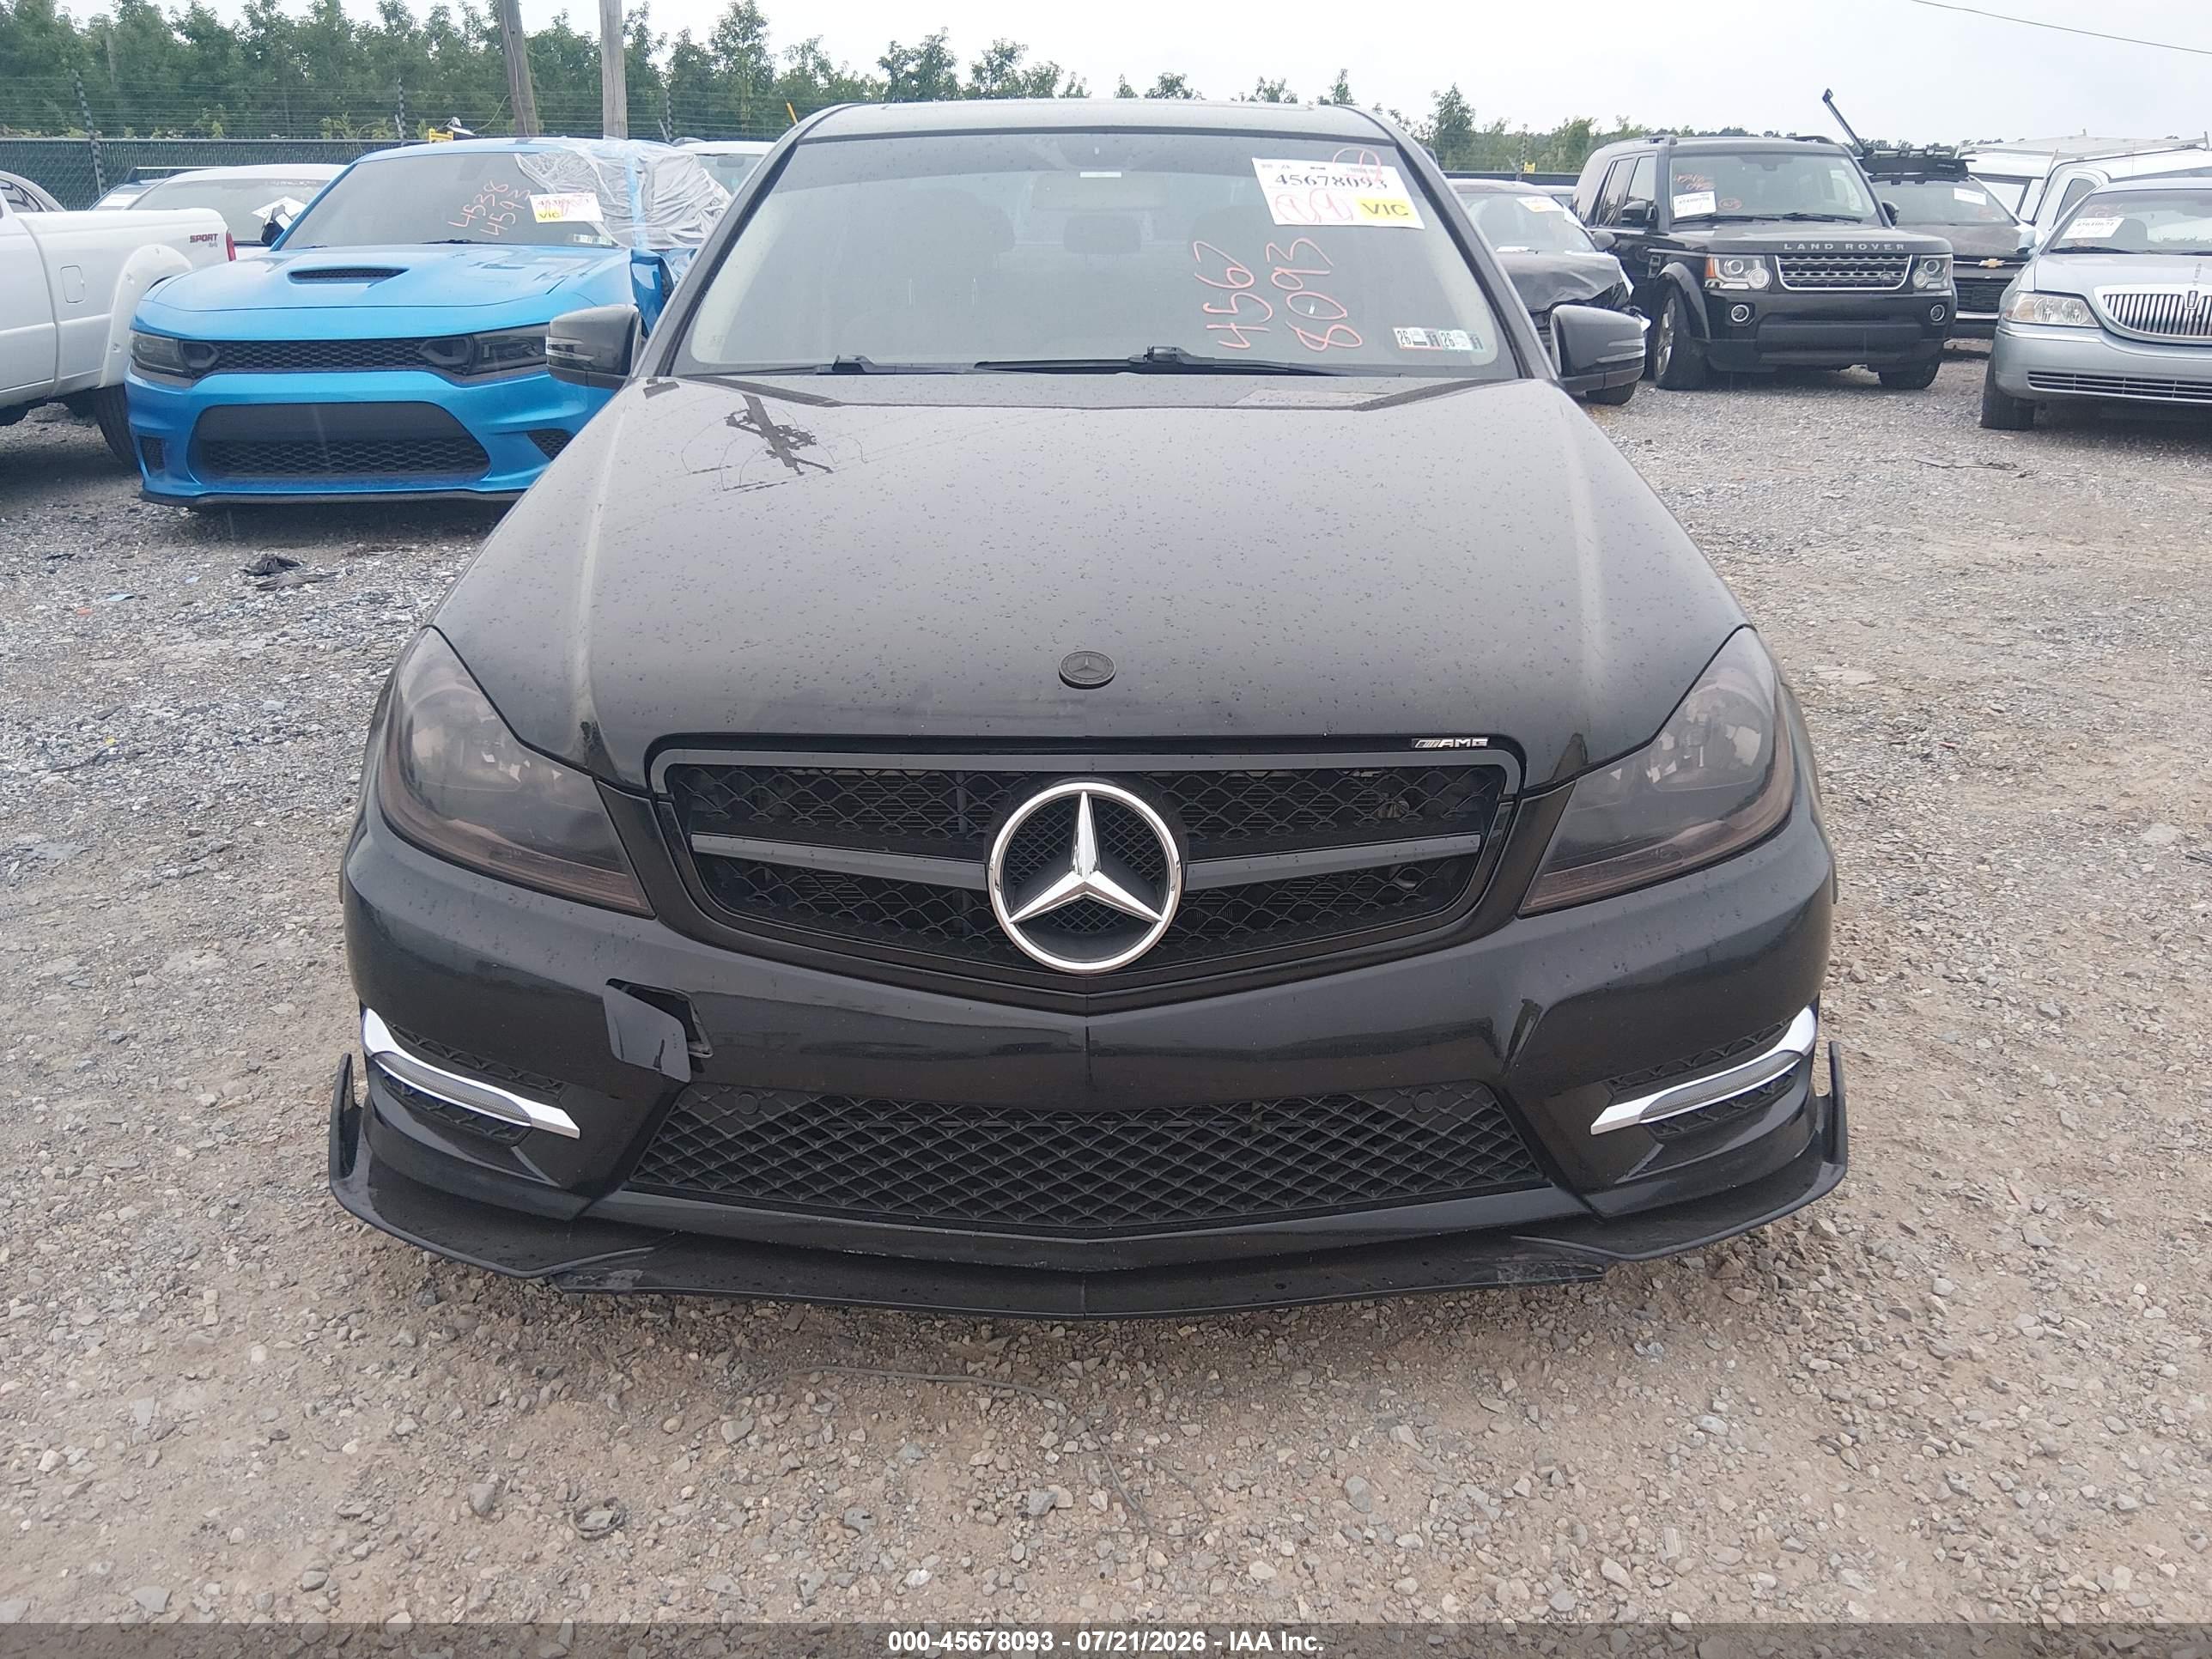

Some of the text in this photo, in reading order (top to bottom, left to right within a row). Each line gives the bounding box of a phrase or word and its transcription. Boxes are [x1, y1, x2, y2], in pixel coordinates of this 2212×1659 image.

[1274, 173, 1388, 189] 45678093
[447, 179, 509, 228] 4538
[1360, 202, 1409, 216] VIC
[479, 189, 532, 236] 4593
[190, 233, 218, 243] SPORT
[1193, 239, 1273, 349] 4567
[1266, 237, 1364, 353] 8093
[1396, 330, 1412, 345] 26
[1441, 332, 1455, 347] 26
